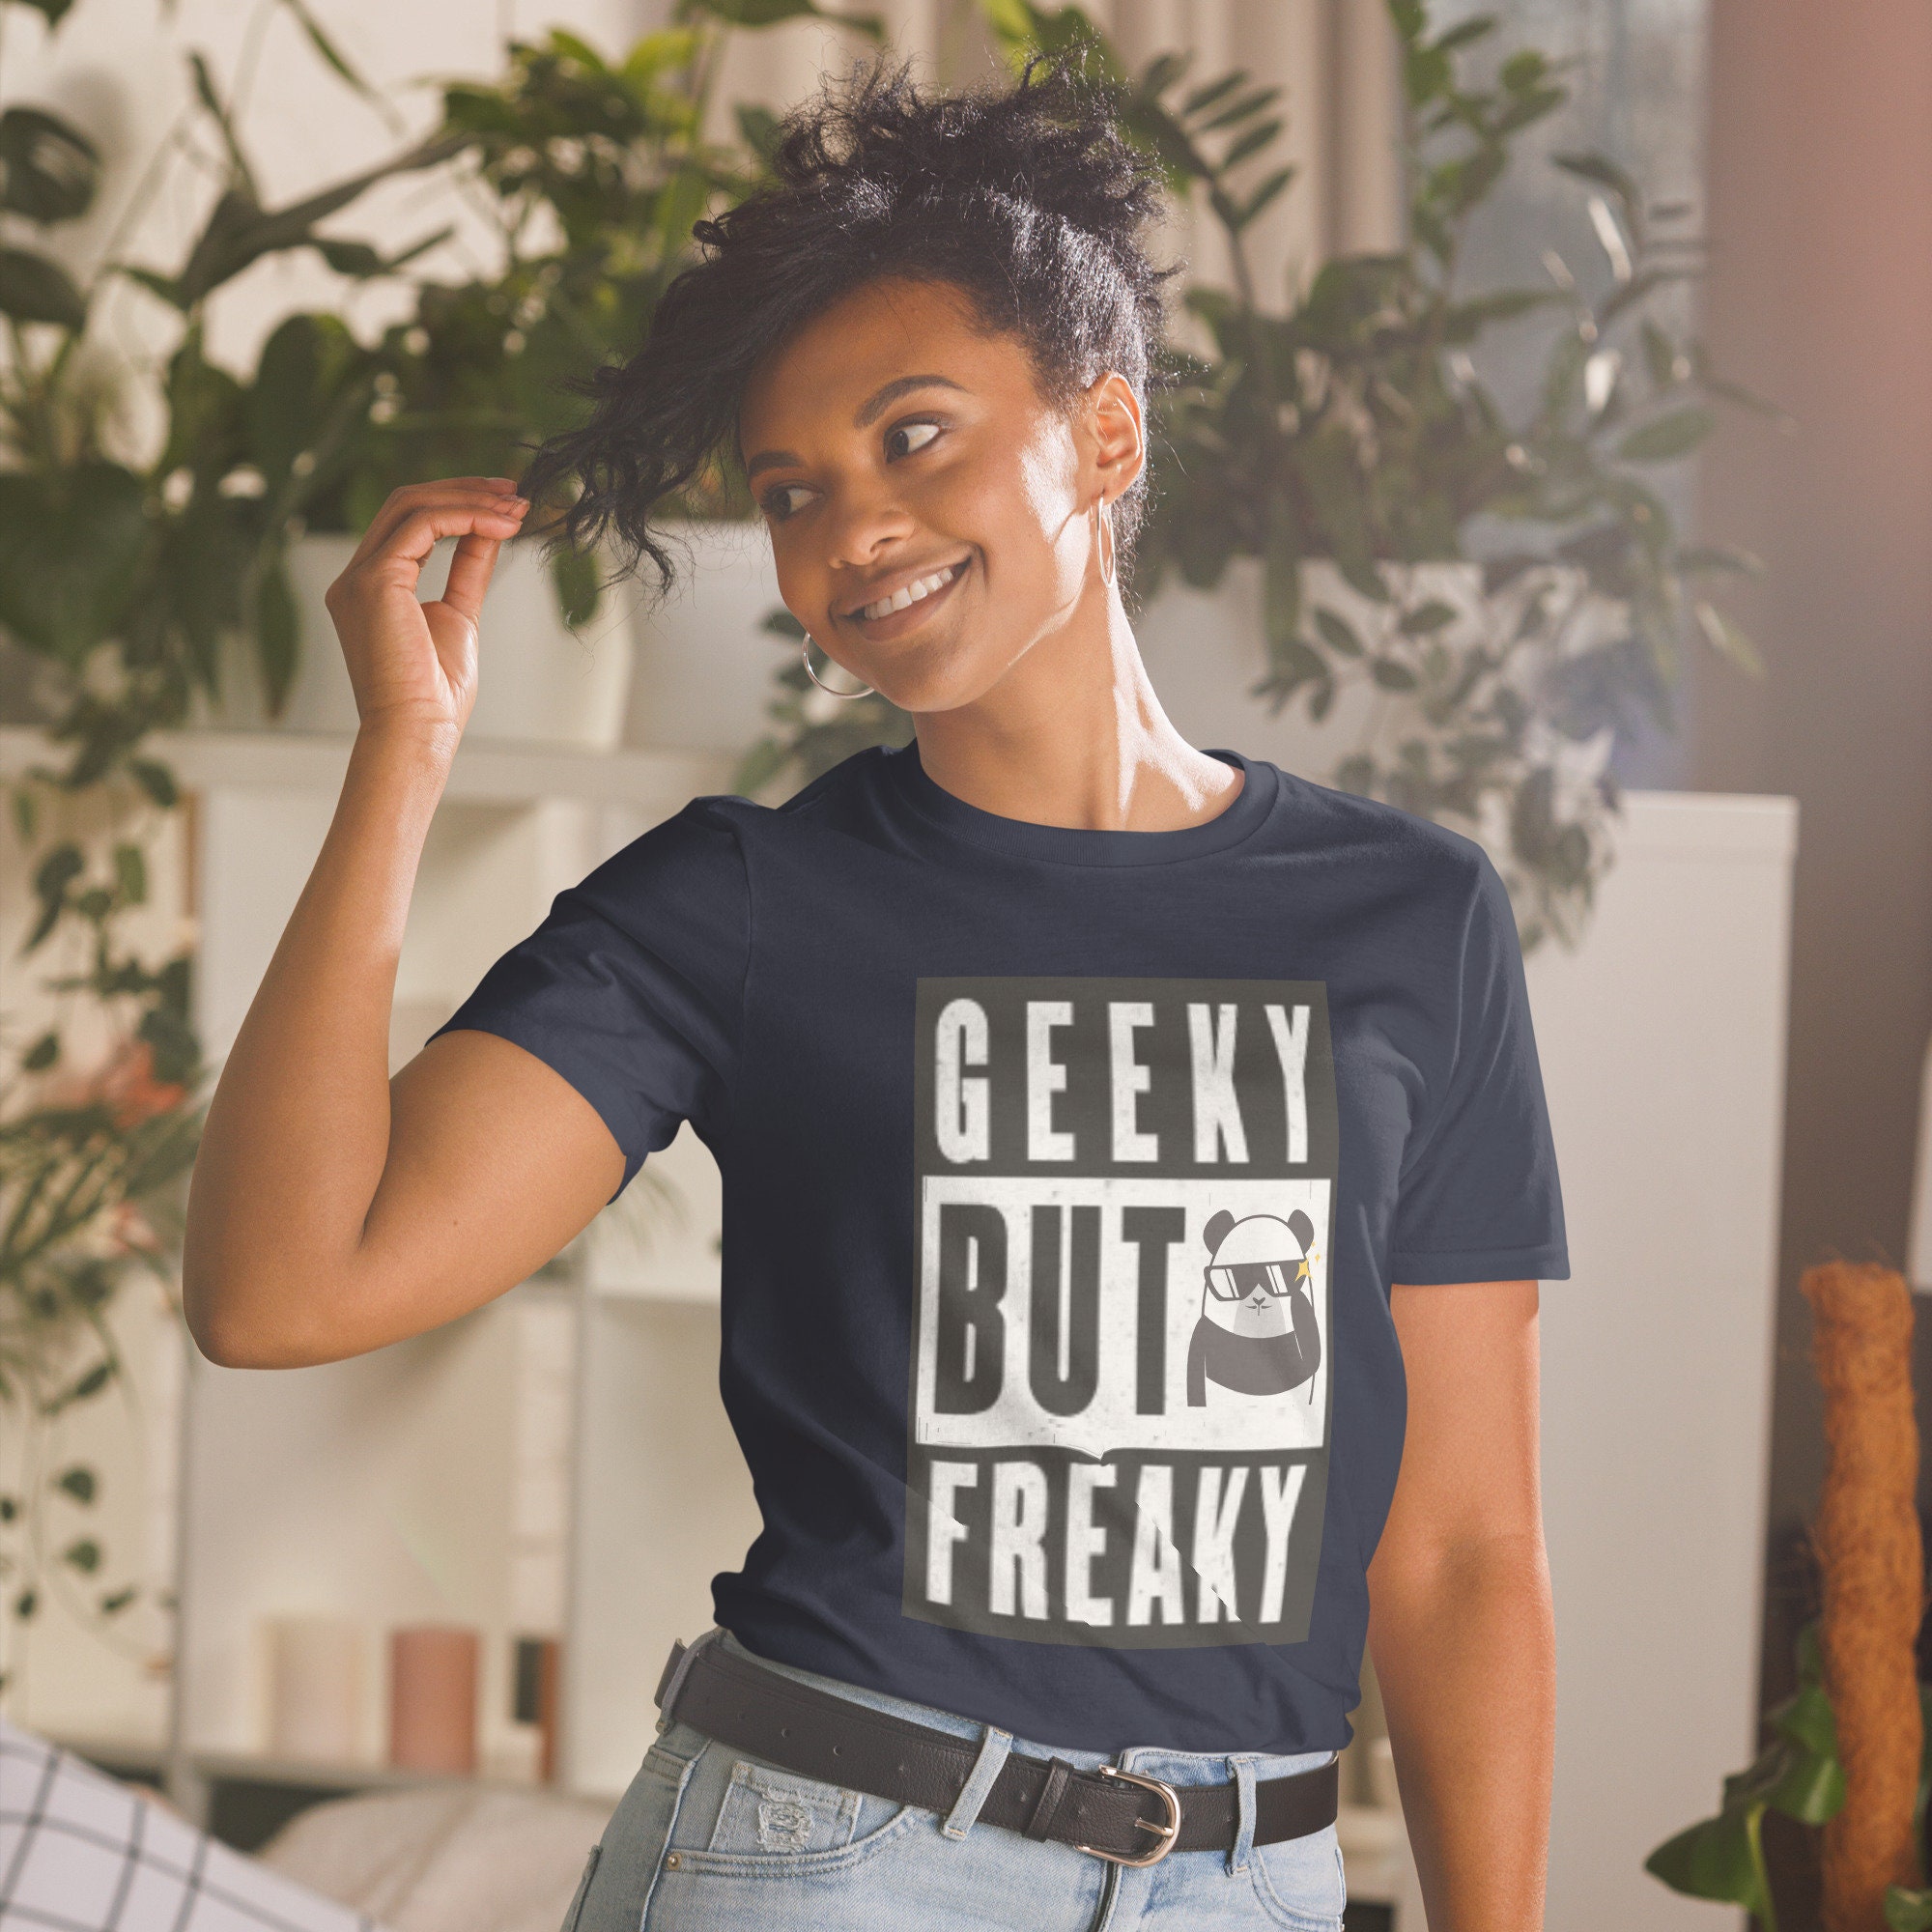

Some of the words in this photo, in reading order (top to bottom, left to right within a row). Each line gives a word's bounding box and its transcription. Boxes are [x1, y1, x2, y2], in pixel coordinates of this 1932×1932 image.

[934, 998, 1312, 1164] GEEKY
[933, 1203, 1187, 1417] BUT
[925, 1460, 1308, 1628] FREAKY
